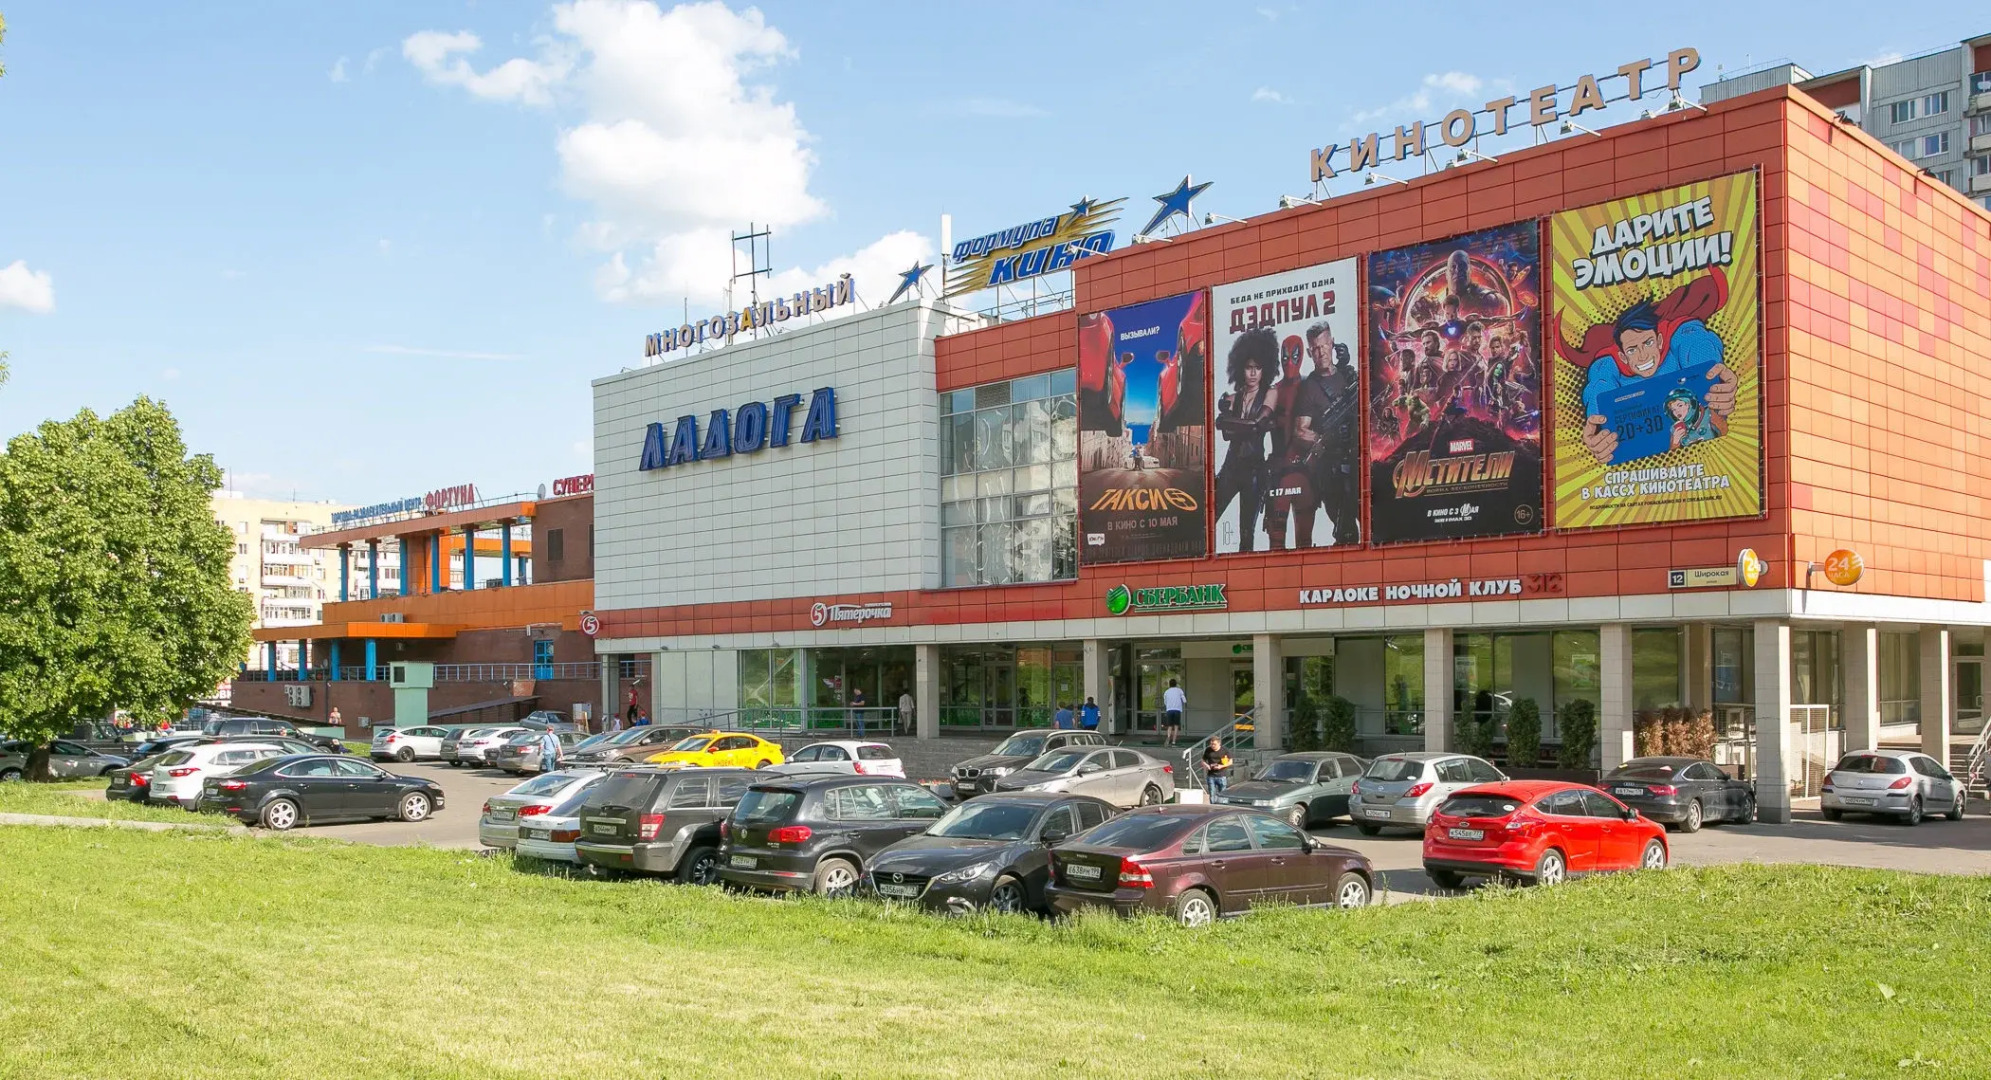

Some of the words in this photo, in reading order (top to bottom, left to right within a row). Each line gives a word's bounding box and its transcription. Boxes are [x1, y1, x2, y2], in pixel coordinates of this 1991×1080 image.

[1310, 47, 1700, 182] КИНОТЕАТР
[1590, 195, 1715, 258] ДАРИТЕ
[1573, 231, 1733, 290] ЭМОЦИИ!
[1230, 294, 1252, 305] БЕДА
[1254, 292, 1264, 300] НЕ
[1266, 283, 1309, 298] ПРИХОДИТ
[1312, 278, 1335, 289] ОДНА
[645, 273, 855, 357] МНОГОЗАЛЬНЫЙ
[1229, 294, 1319, 334] ДЭДПУЛ
[1323, 290, 1336, 315] 2
[1120, 326, 1160, 341] ВЫЗЫВАЛИ?
[639, 387, 839, 472] ЛАДОГА
[1450, 440, 1473, 452] MARVEL
[1605, 463, 1704, 485] СПРАШИВАЙТЕ
[425, 483, 474, 509] ФОРТУНА
[1089, 488, 1168, 511] ТАКСИ
[1275, 488, 1284, 496] 17
[1284, 487, 1302, 496] МАЯ
[1581, 487, 1590, 500] В
[1594, 483, 1635, 499] КАССХ
[1639, 475, 1730, 495] КИНОТЕАТРА
[1107, 522, 1113, 531] В
[1115, 520, 1137, 530] КИНО
[1139, 520, 1145, 528] С
[1160, 516, 1178, 527] МАЯ
[1427, 509, 1432, 517] В
[1432, 508, 1449, 517] КИНО
[1516, 509, 1530, 519] 16+
[1223, 521, 1234, 545] 18+
[1695, 570, 1729, 578] Широкая
[1828, 557, 1849, 571] 24
[1672, 574, 1683, 583] 12
[1132, 583, 1227, 607] СБЕРБАНК
[1299, 586, 1379, 604] КАРАОКЕ
[1385, 578, 1461, 600] НОЧНОЙ
[1469, 579, 1522, 596] КЛУБ
